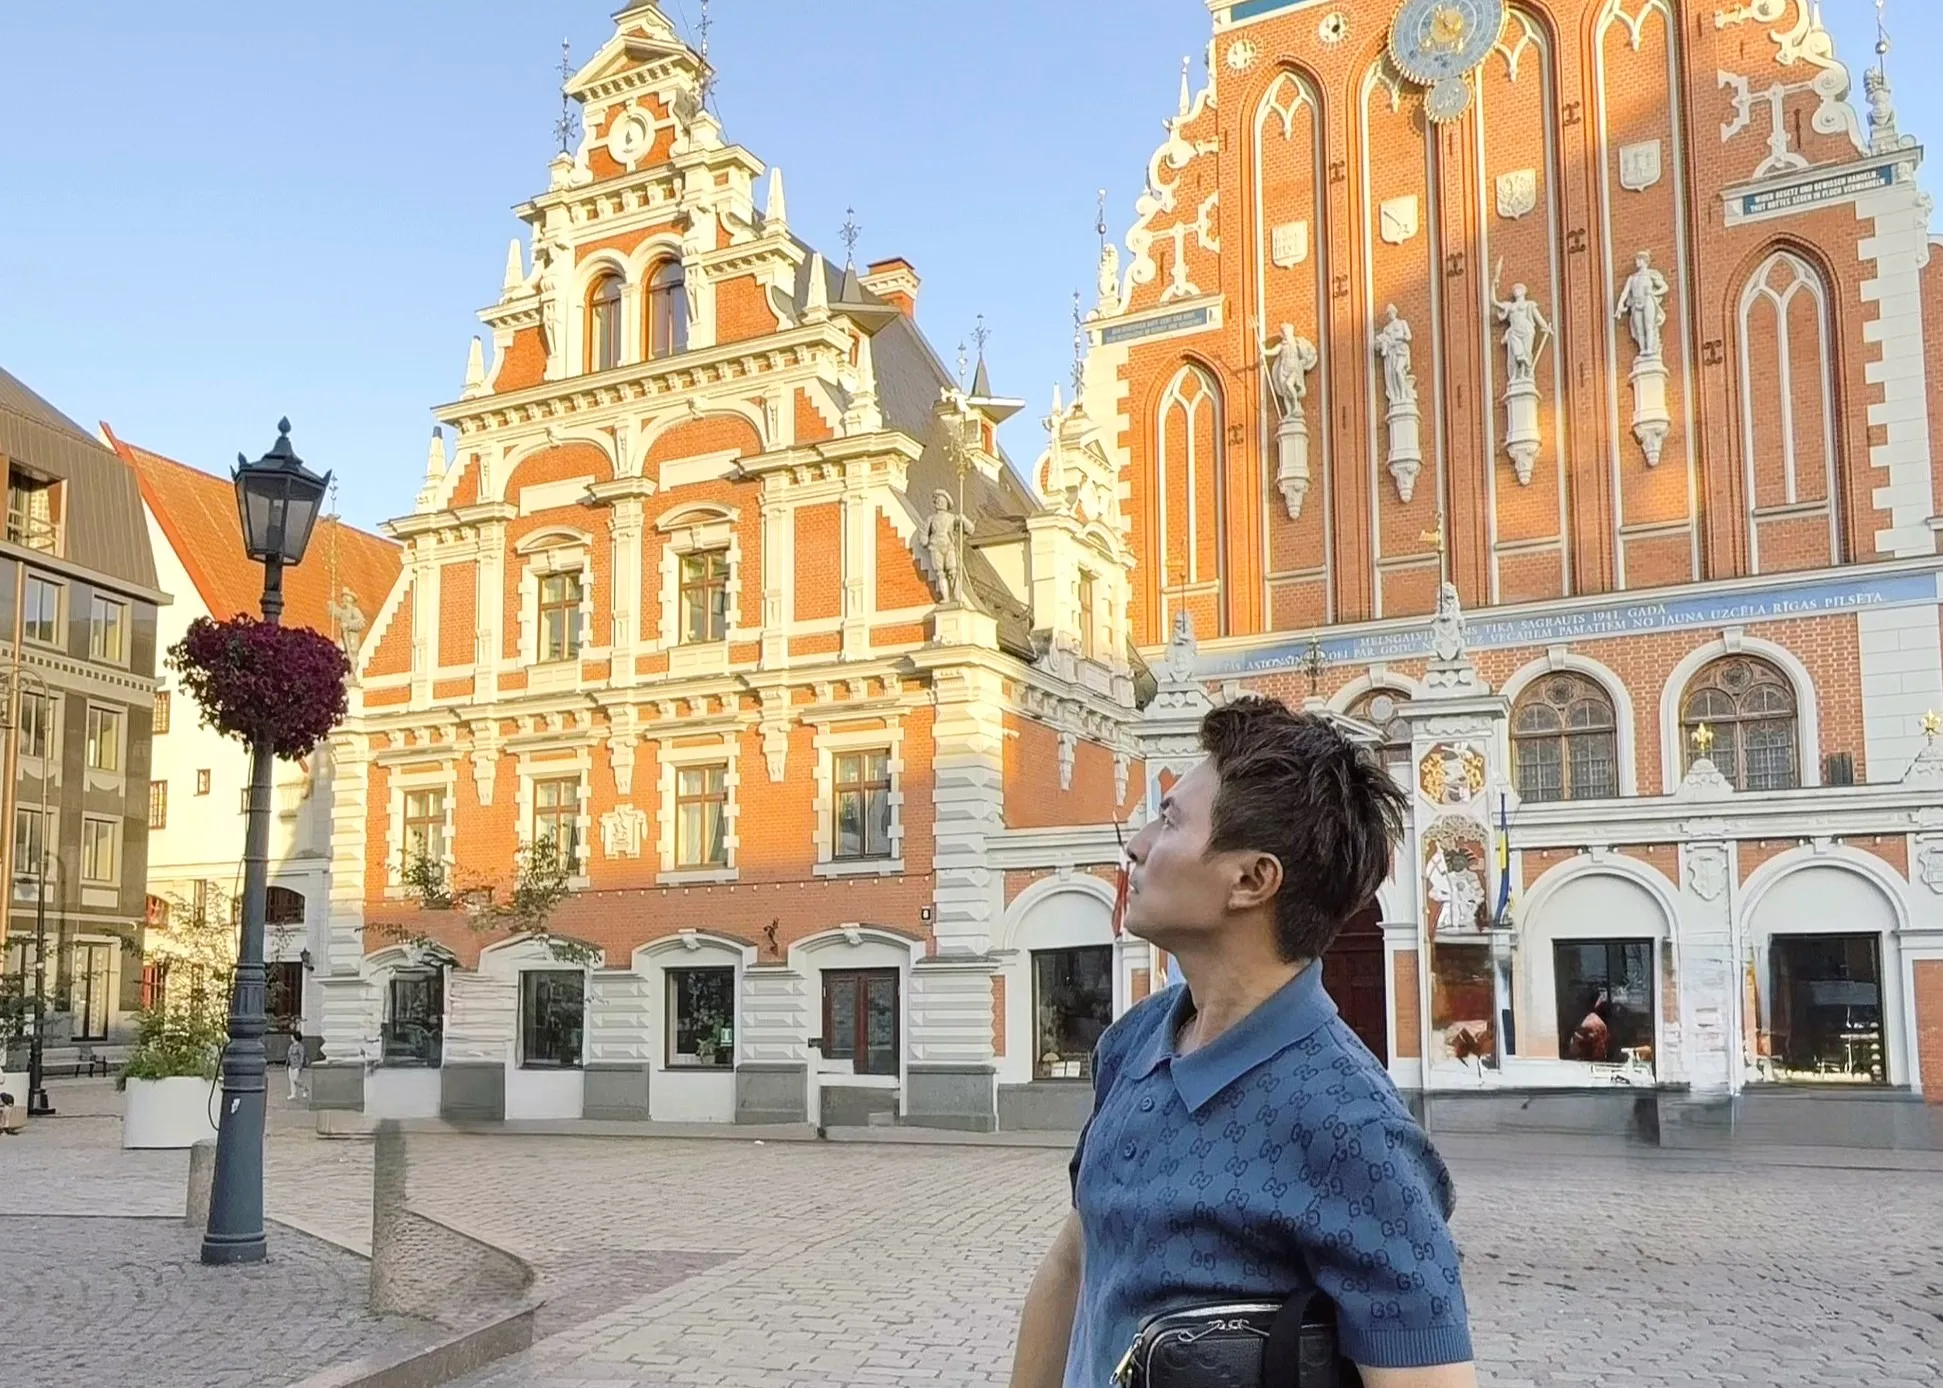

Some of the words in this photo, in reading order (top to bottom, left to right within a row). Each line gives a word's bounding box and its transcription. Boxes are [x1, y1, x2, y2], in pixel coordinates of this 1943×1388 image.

[1484, 621, 1514, 634] TIKA
[1520, 613, 1586, 631] SAGRAUTS
[1559, 619, 1626, 637] PAMATIEM
[1631, 617, 1654, 629] NO
